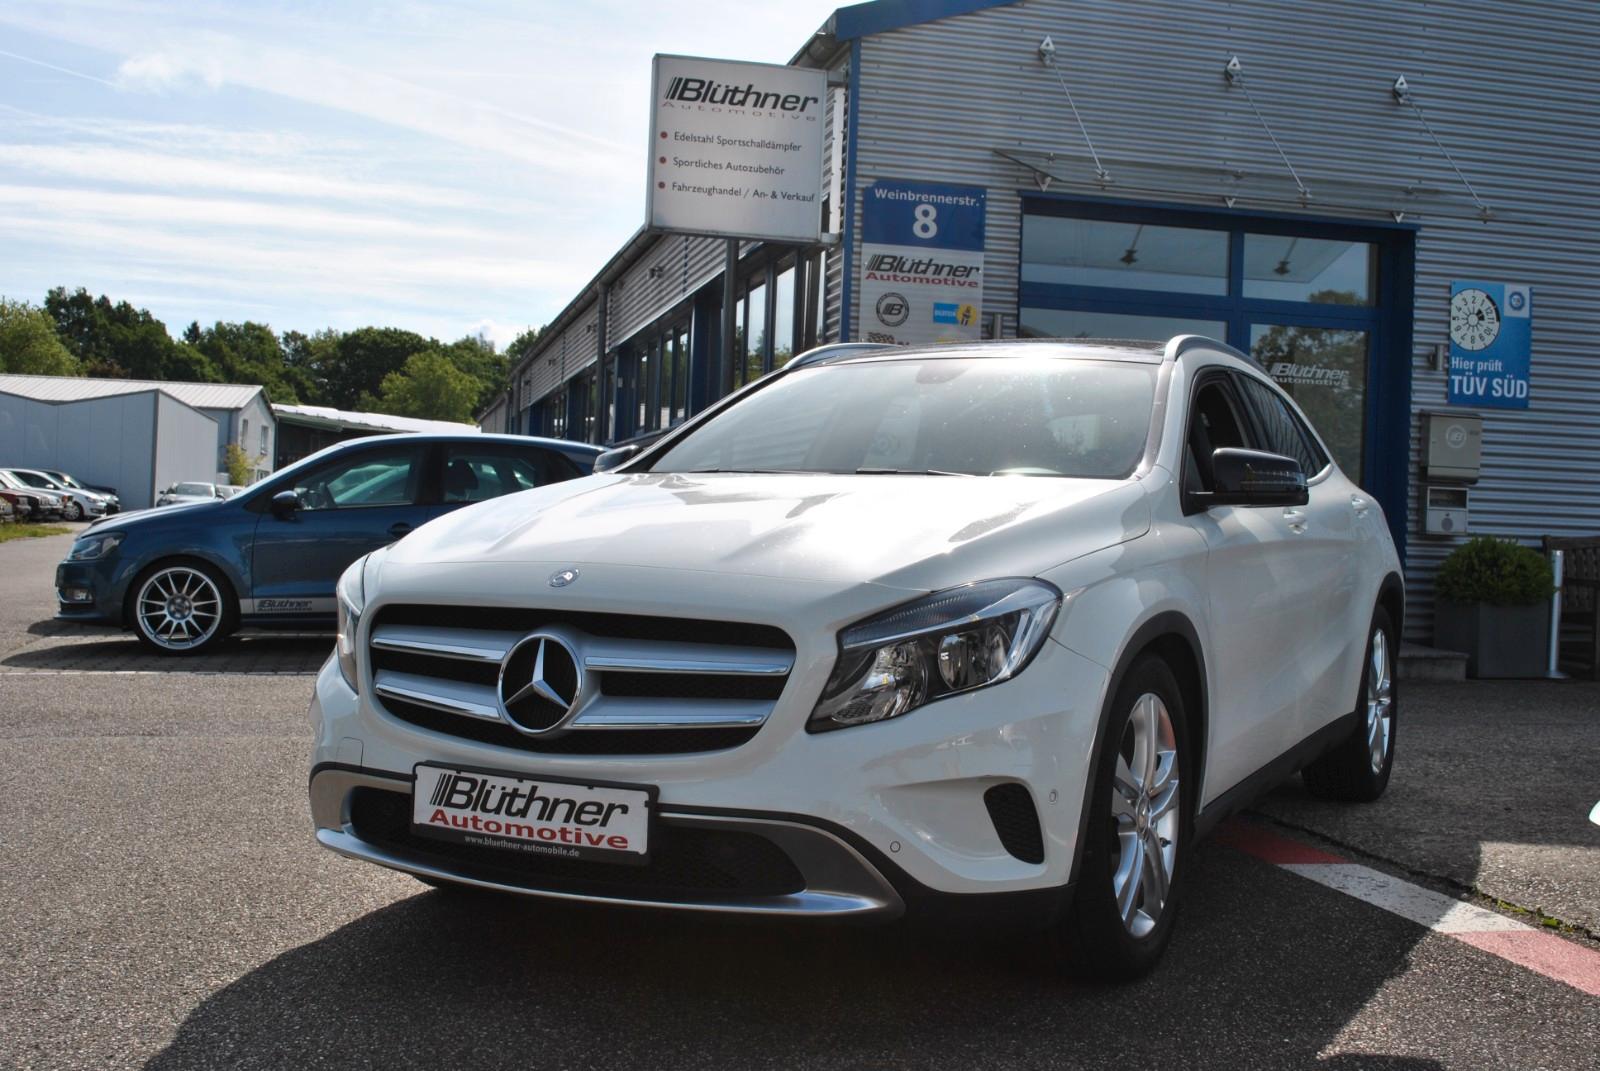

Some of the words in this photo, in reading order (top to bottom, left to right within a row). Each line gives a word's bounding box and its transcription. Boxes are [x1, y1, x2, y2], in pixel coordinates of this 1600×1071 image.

[676, 77, 818, 112] Blüthner
[661, 101, 817, 122] Automotive
[674, 131, 715, 145] Edelstahl
[716, 135, 803, 153] Sportschalldämpfer
[672, 156, 724, 171] Sportliches
[725, 161, 786, 176] Autozubehör
[672, 183, 742, 198] Fahrzeughandel
[752, 188, 769, 199] An-
[770, 190, 778, 199] &
[780, 191, 816, 202] Verkauf
[874, 187, 980, 207] Weinbrennerstr.
[912, 203, 938, 239] 8
[875, 255, 980, 278] Blüthner
[865, 271, 979, 289] Automotive
[1277, 362, 1350, 379] Blüthner
[1451, 356, 1475, 369] Hier
[1476, 359, 1503, 373] prüft
[1451, 371, 1488, 396] TÜV
[1491, 374, 1528, 398] SÜD
[443, 774, 629, 828] Blüthner
[429, 808, 629, 849] Automotive
[465, 835, 580, 857] www.bluethner-automobile.de
